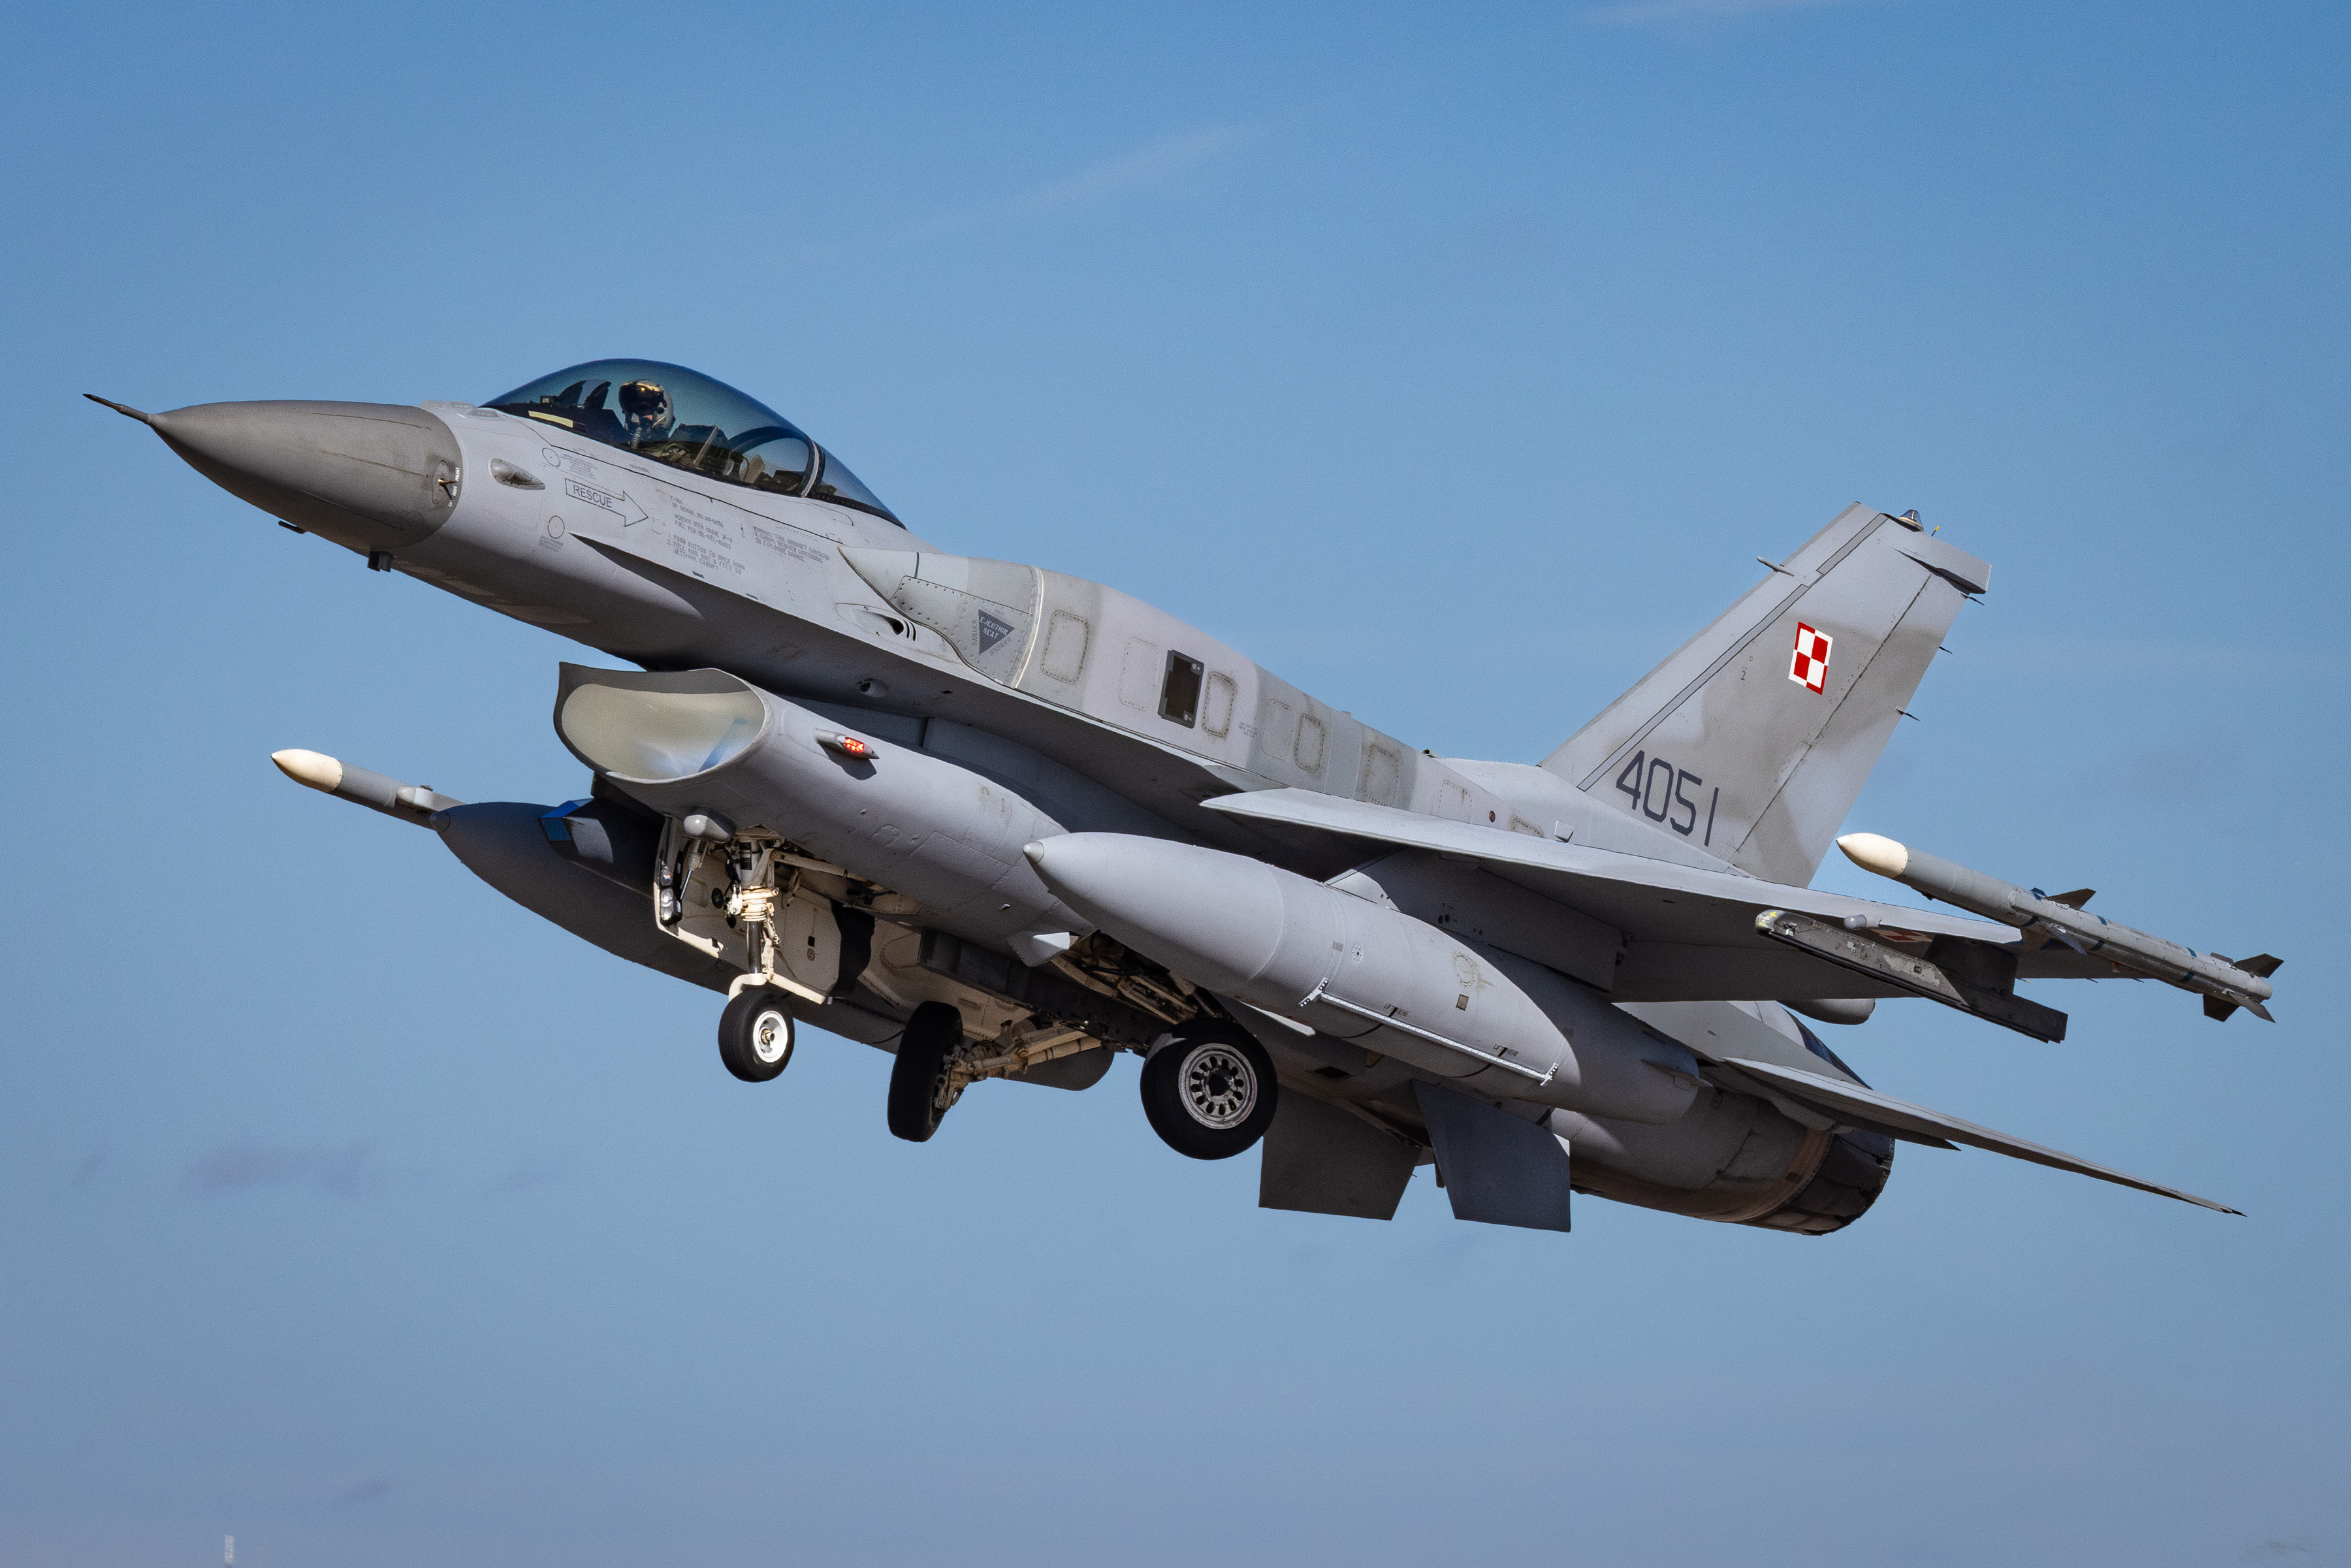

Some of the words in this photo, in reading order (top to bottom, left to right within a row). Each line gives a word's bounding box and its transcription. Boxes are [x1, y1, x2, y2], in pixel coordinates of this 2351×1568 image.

[573, 485, 613, 508] RESCUE
[980, 616, 1008, 635] EJECTION
[983, 628, 999, 639] SEAT
[1616, 750, 1719, 847] 4051
[1398, 1008, 1409, 1017] HERE
